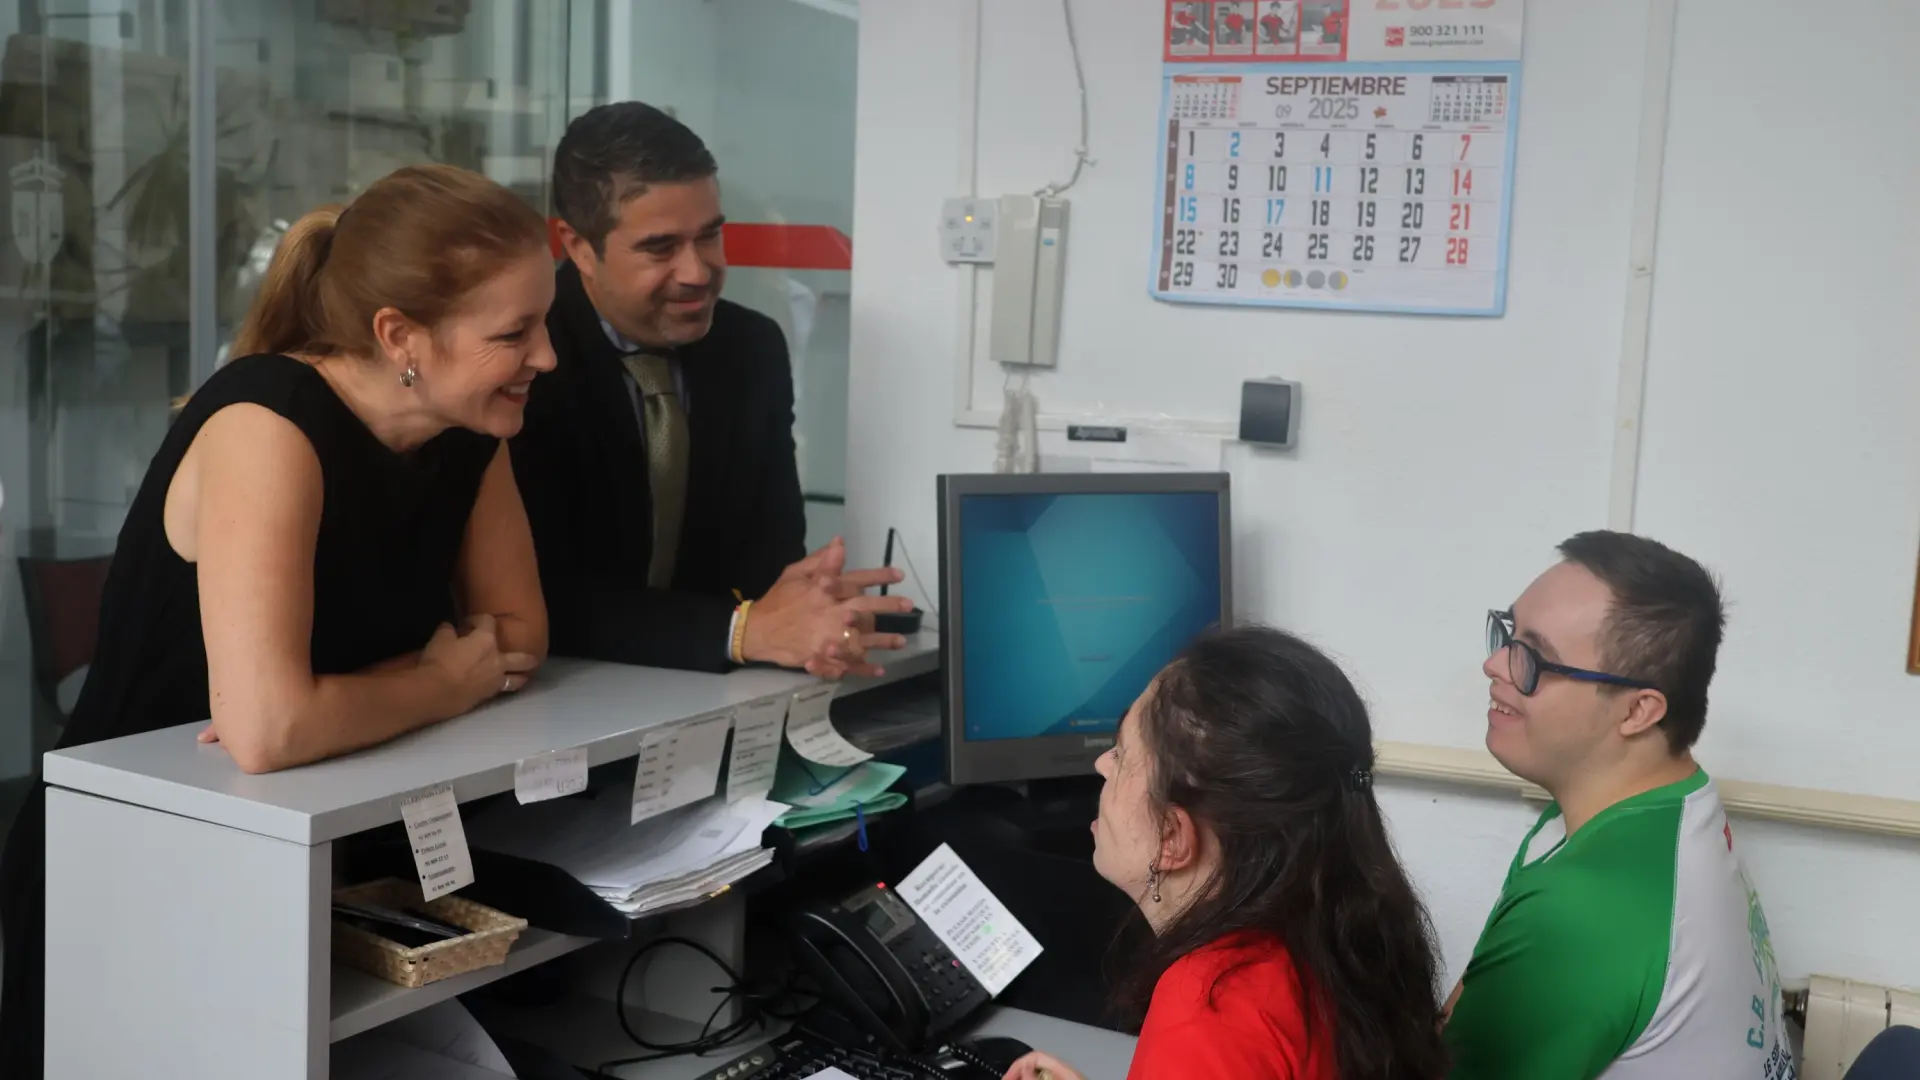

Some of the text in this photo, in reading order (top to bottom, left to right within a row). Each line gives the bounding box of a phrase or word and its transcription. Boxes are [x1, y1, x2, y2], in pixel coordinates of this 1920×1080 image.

[1409, 25, 1484, 37] 900 321 111
[1265, 75, 1408, 96] SEPTIEMBRE
[1275, 97, 1359, 120] 09 2025
[1189, 131, 1471, 160] 1 2 3 4 5 6 7
[1185, 164, 1471, 195] 8 9 10 11 12 13 14
[1180, 197, 1470, 230] 15 16 17 18 19 20 21
[1177, 230, 1468, 264] 22 23 24 25 26 27 28
[1173, 262, 1193, 286] 29
[1217, 263, 1237, 288] 30
